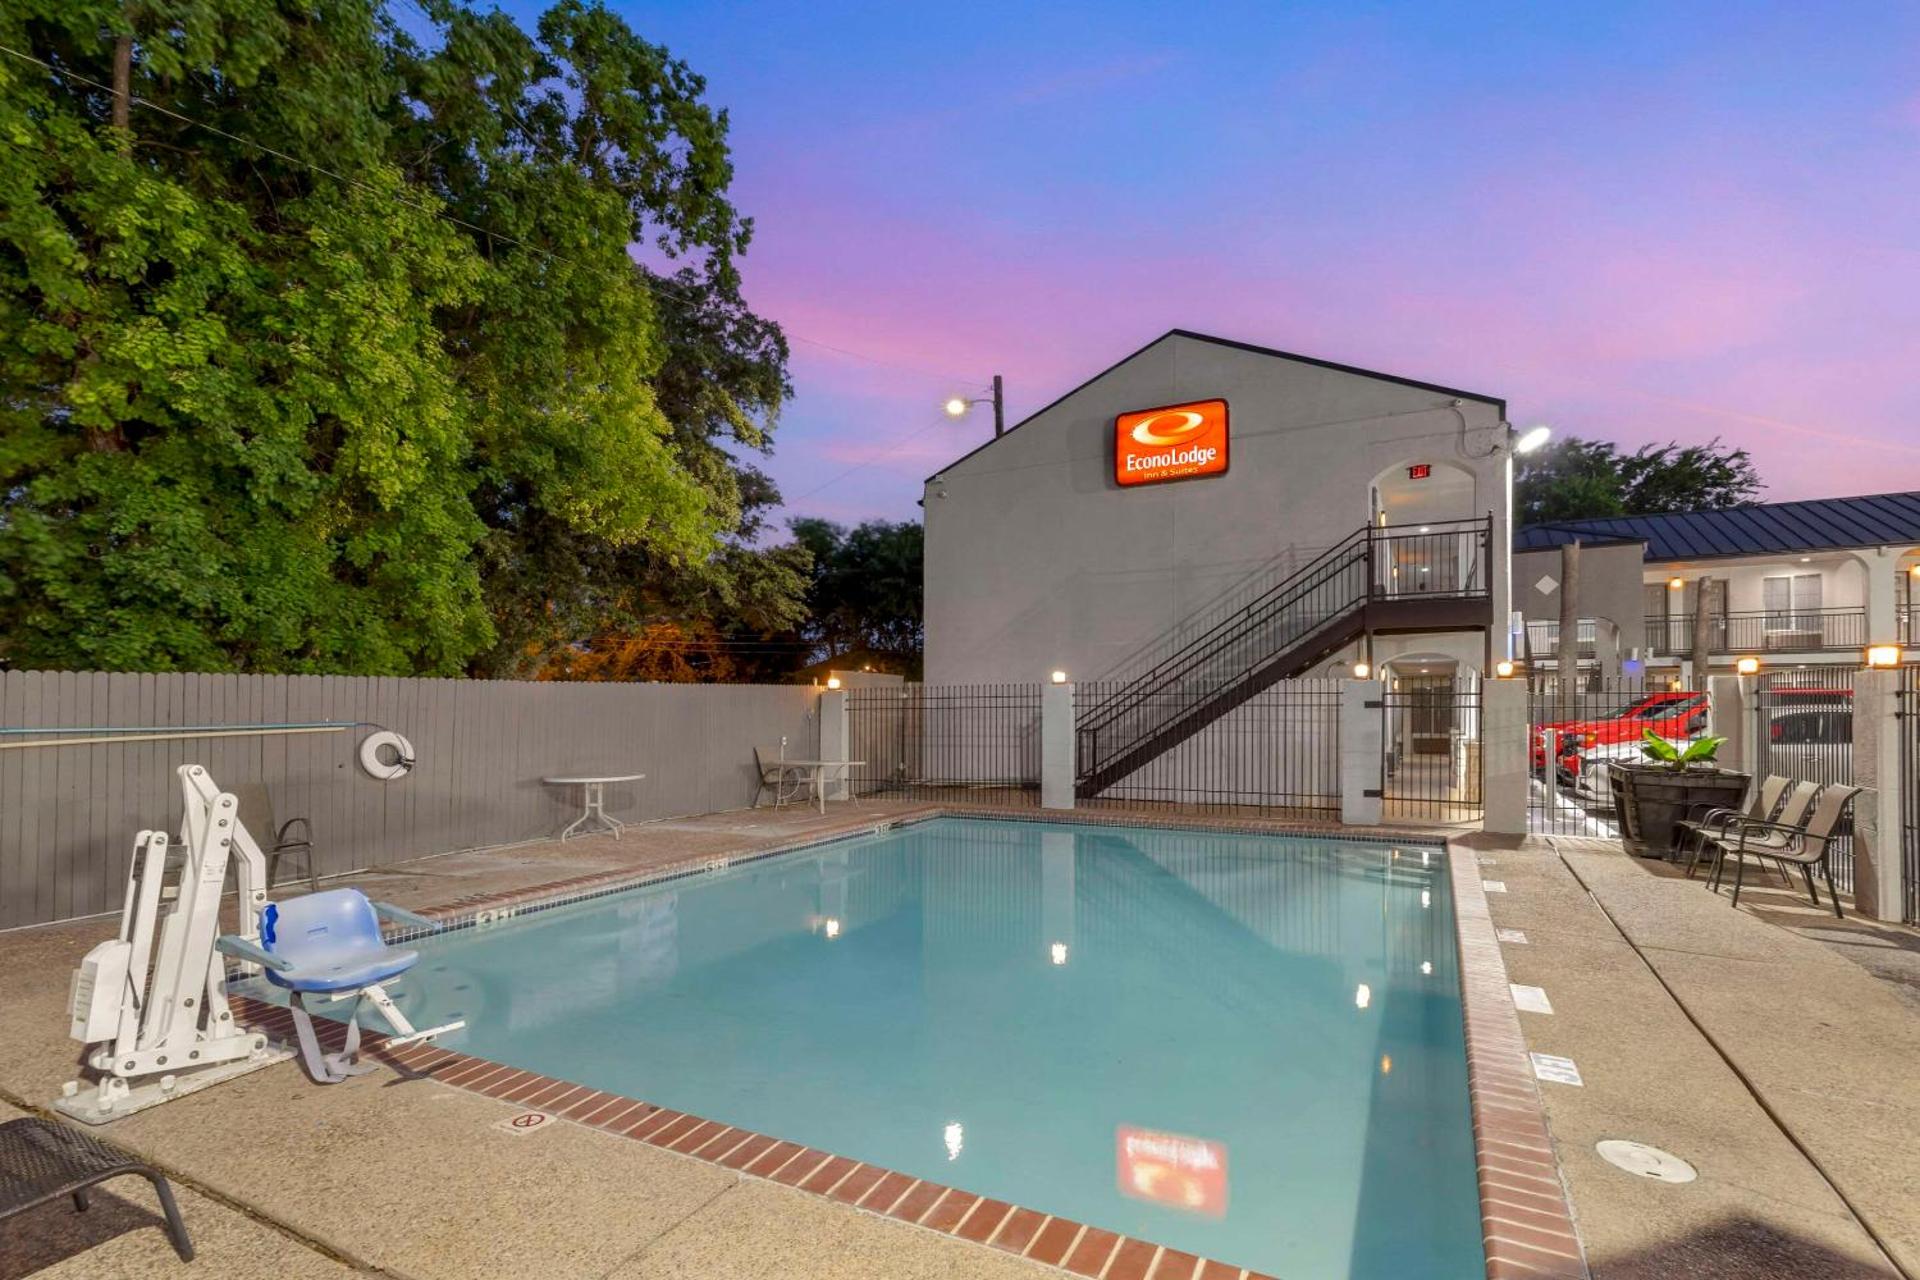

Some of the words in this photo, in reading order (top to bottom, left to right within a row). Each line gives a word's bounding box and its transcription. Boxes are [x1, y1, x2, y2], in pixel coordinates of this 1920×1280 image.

[1143, 470, 1159, 480] Inn
[1160, 469, 1169, 477] &
[1169, 466, 1199, 476] Suites
